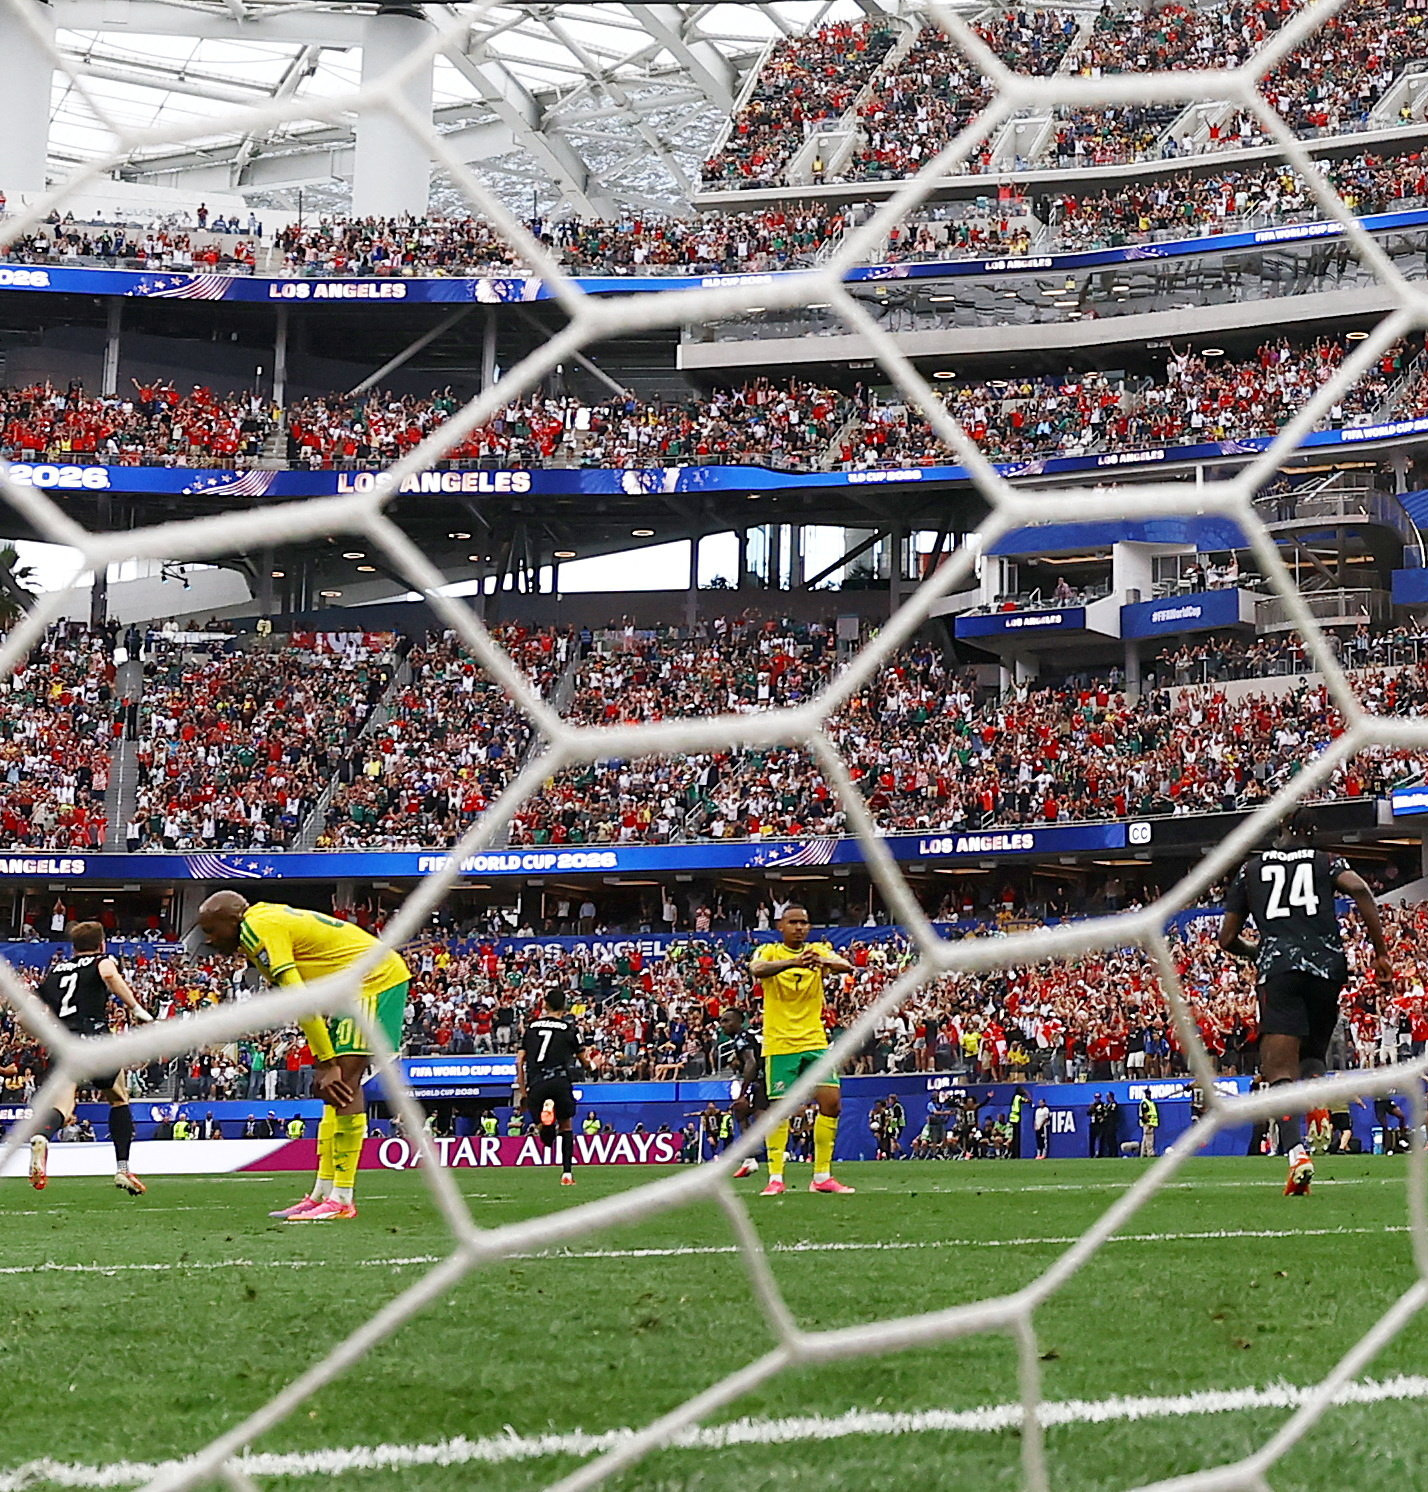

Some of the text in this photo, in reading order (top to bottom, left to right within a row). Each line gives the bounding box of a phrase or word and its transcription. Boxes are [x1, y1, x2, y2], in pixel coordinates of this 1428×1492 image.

[269, 283, 406, 298] LOS ANGELES
[400, 471, 531, 493] ANGELES
[1132, 826, 1149, 841] CC
[919, 833, 1034, 854] LOS ANGELES
[460, 855, 522, 871] WORLD
[522, 854, 557, 870] CUP
[557, 852, 617, 869] 2026
[1262, 849, 1315, 862] PROMISE
[1261, 862, 1319, 919] 24
[793, 973, 802, 992] 7
[58, 972, 78, 1018] 2
[537, 1030, 553, 1063] 7
[410, 1066, 433, 1077] FIFA
[433, 1066, 470, 1076] WORLD
[470, 1065, 491, 1075] CUP
